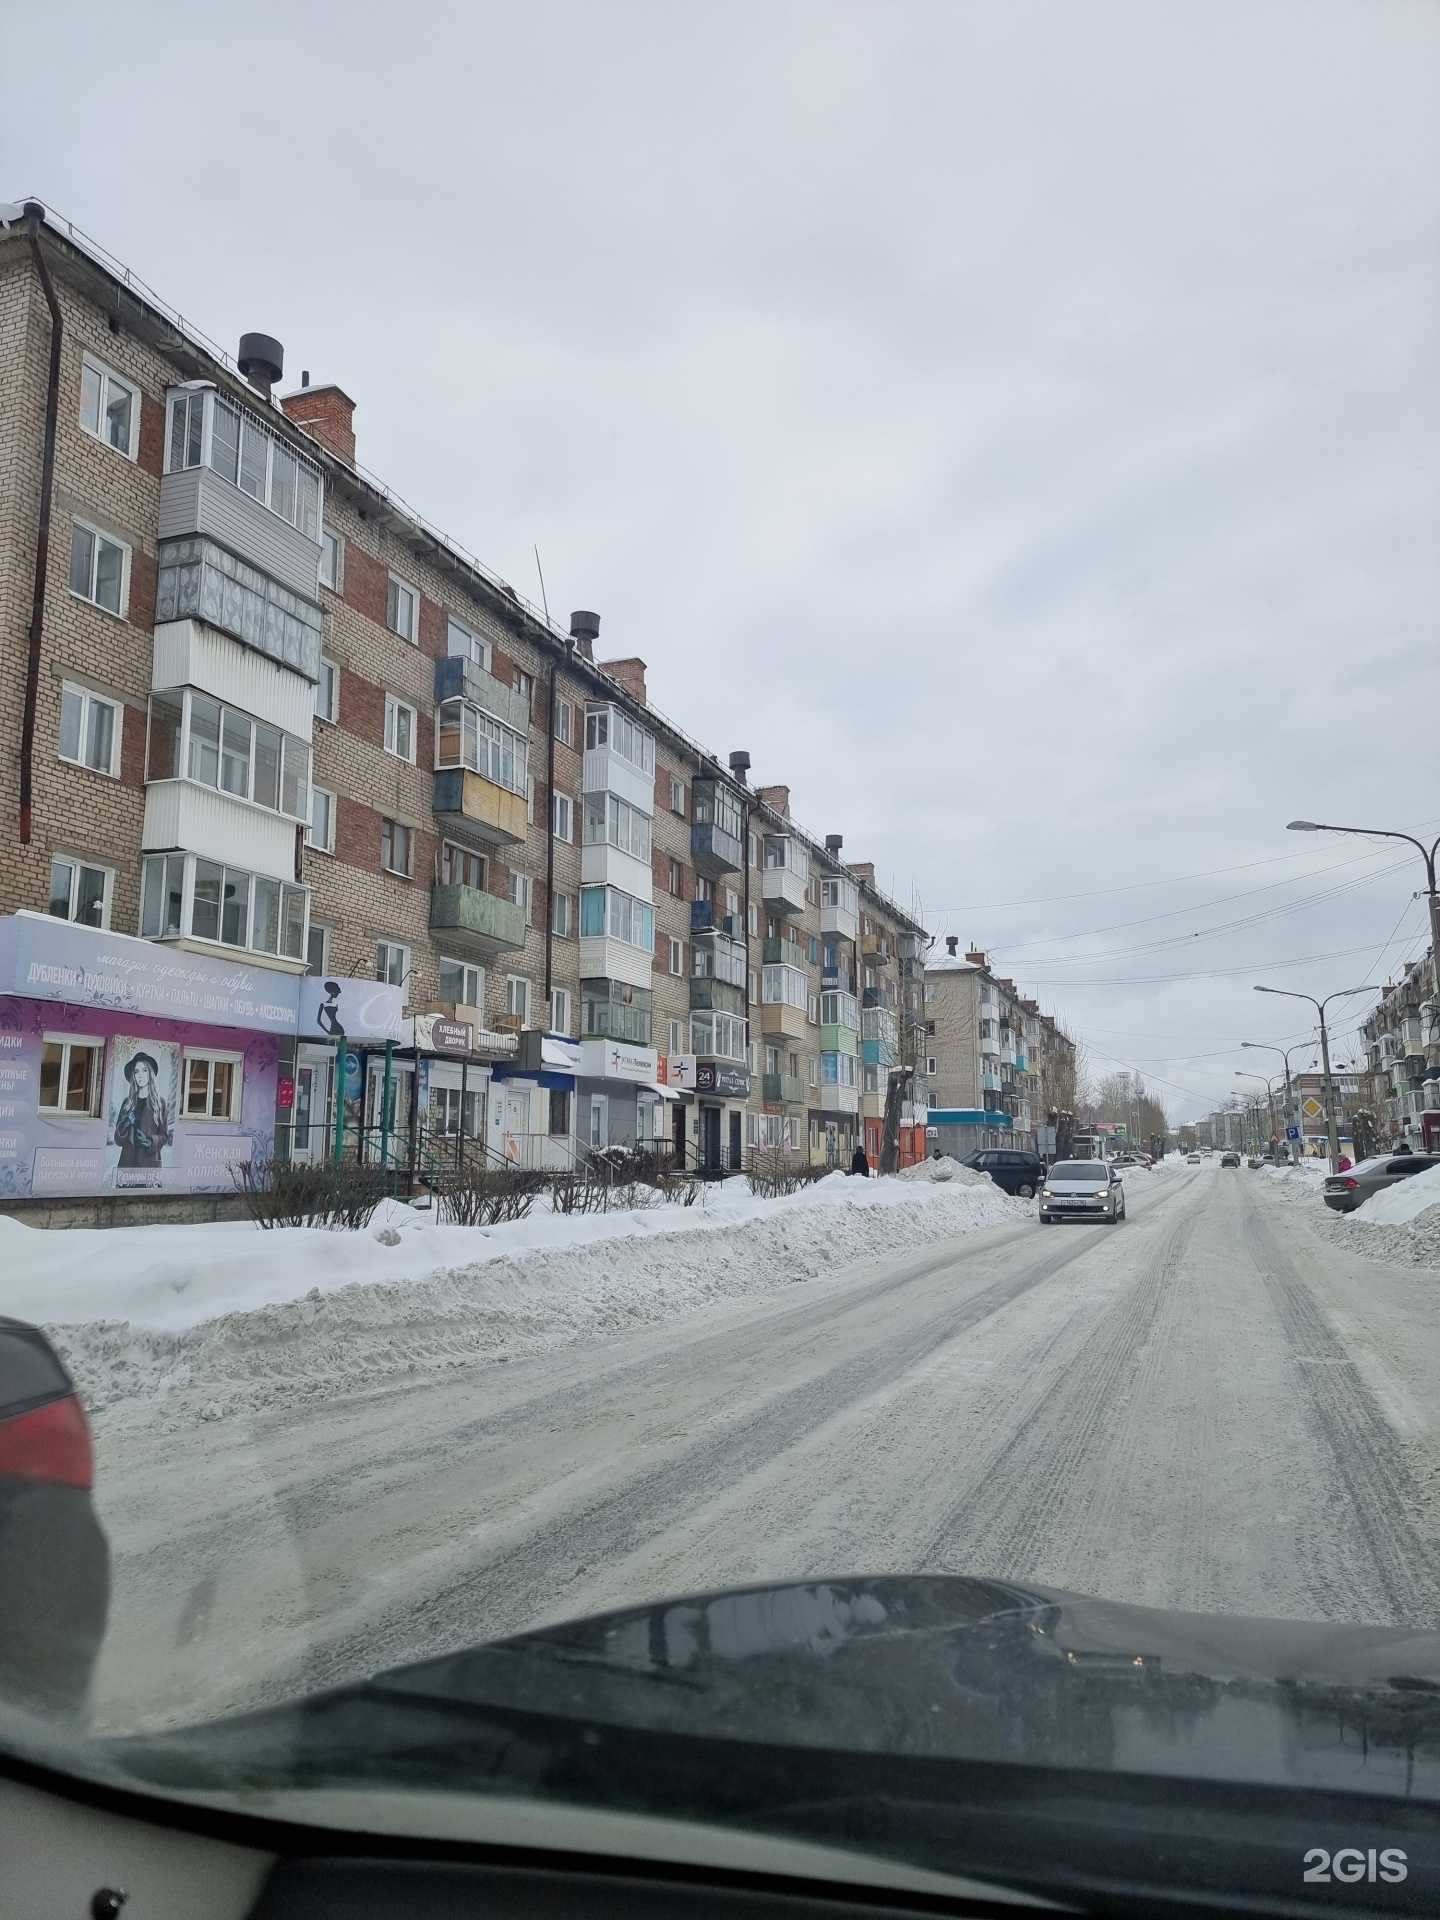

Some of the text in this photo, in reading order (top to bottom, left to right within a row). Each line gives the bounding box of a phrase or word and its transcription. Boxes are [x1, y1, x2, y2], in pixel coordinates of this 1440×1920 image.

[439, 1024, 467, 1036] ХЛЕБНЫЙ
[444, 1035, 466, 1047] ДВОРИК
[698, 1071, 710, 1081] 24
